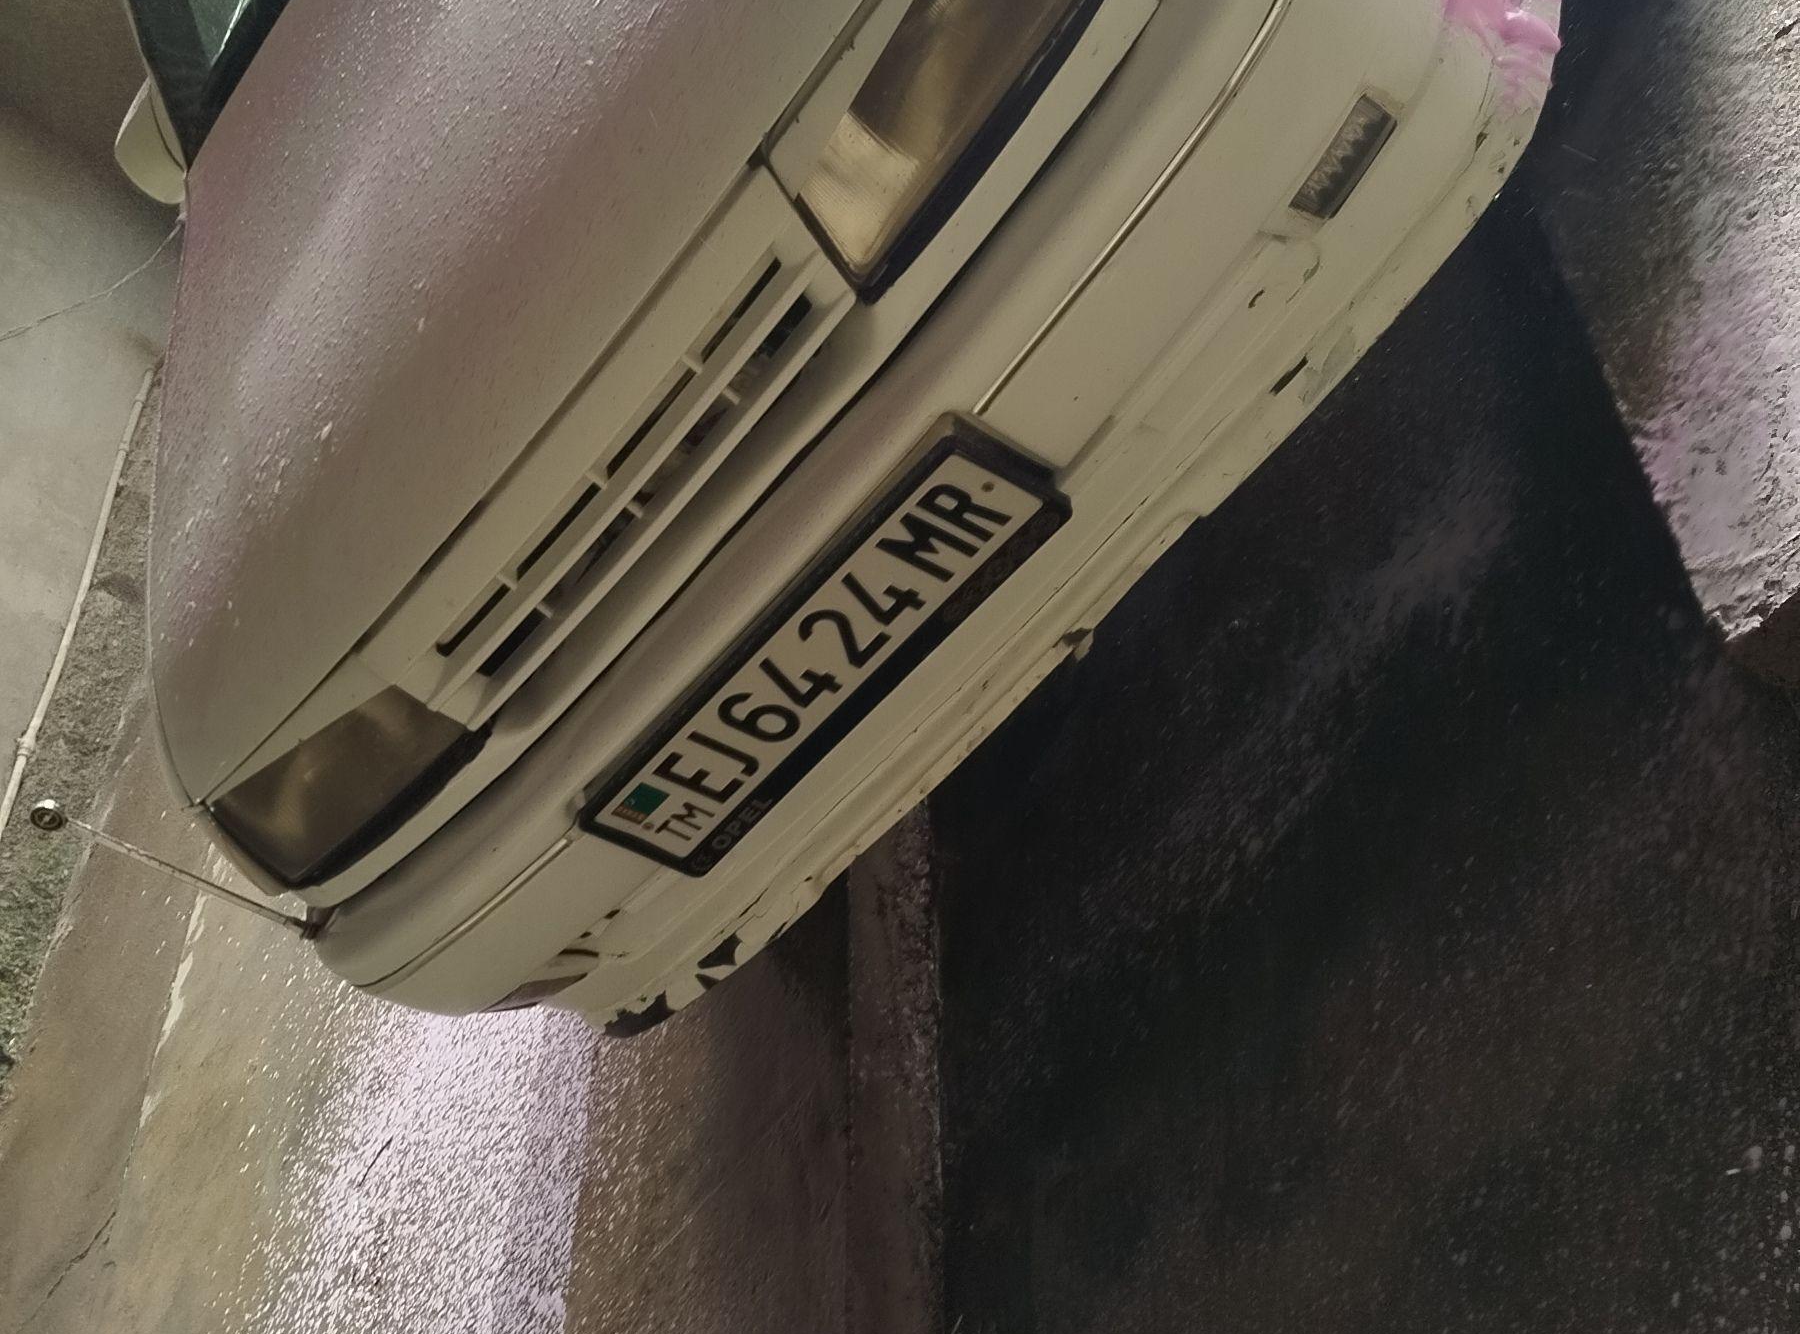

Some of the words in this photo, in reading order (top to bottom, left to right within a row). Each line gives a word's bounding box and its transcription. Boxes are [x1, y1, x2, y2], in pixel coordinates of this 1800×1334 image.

[652, 731, 759, 804] EJ
[876, 483, 1012, 583] MR
[654, 802, 715, 842] TM
[711, 798, 773, 850] OPEL
